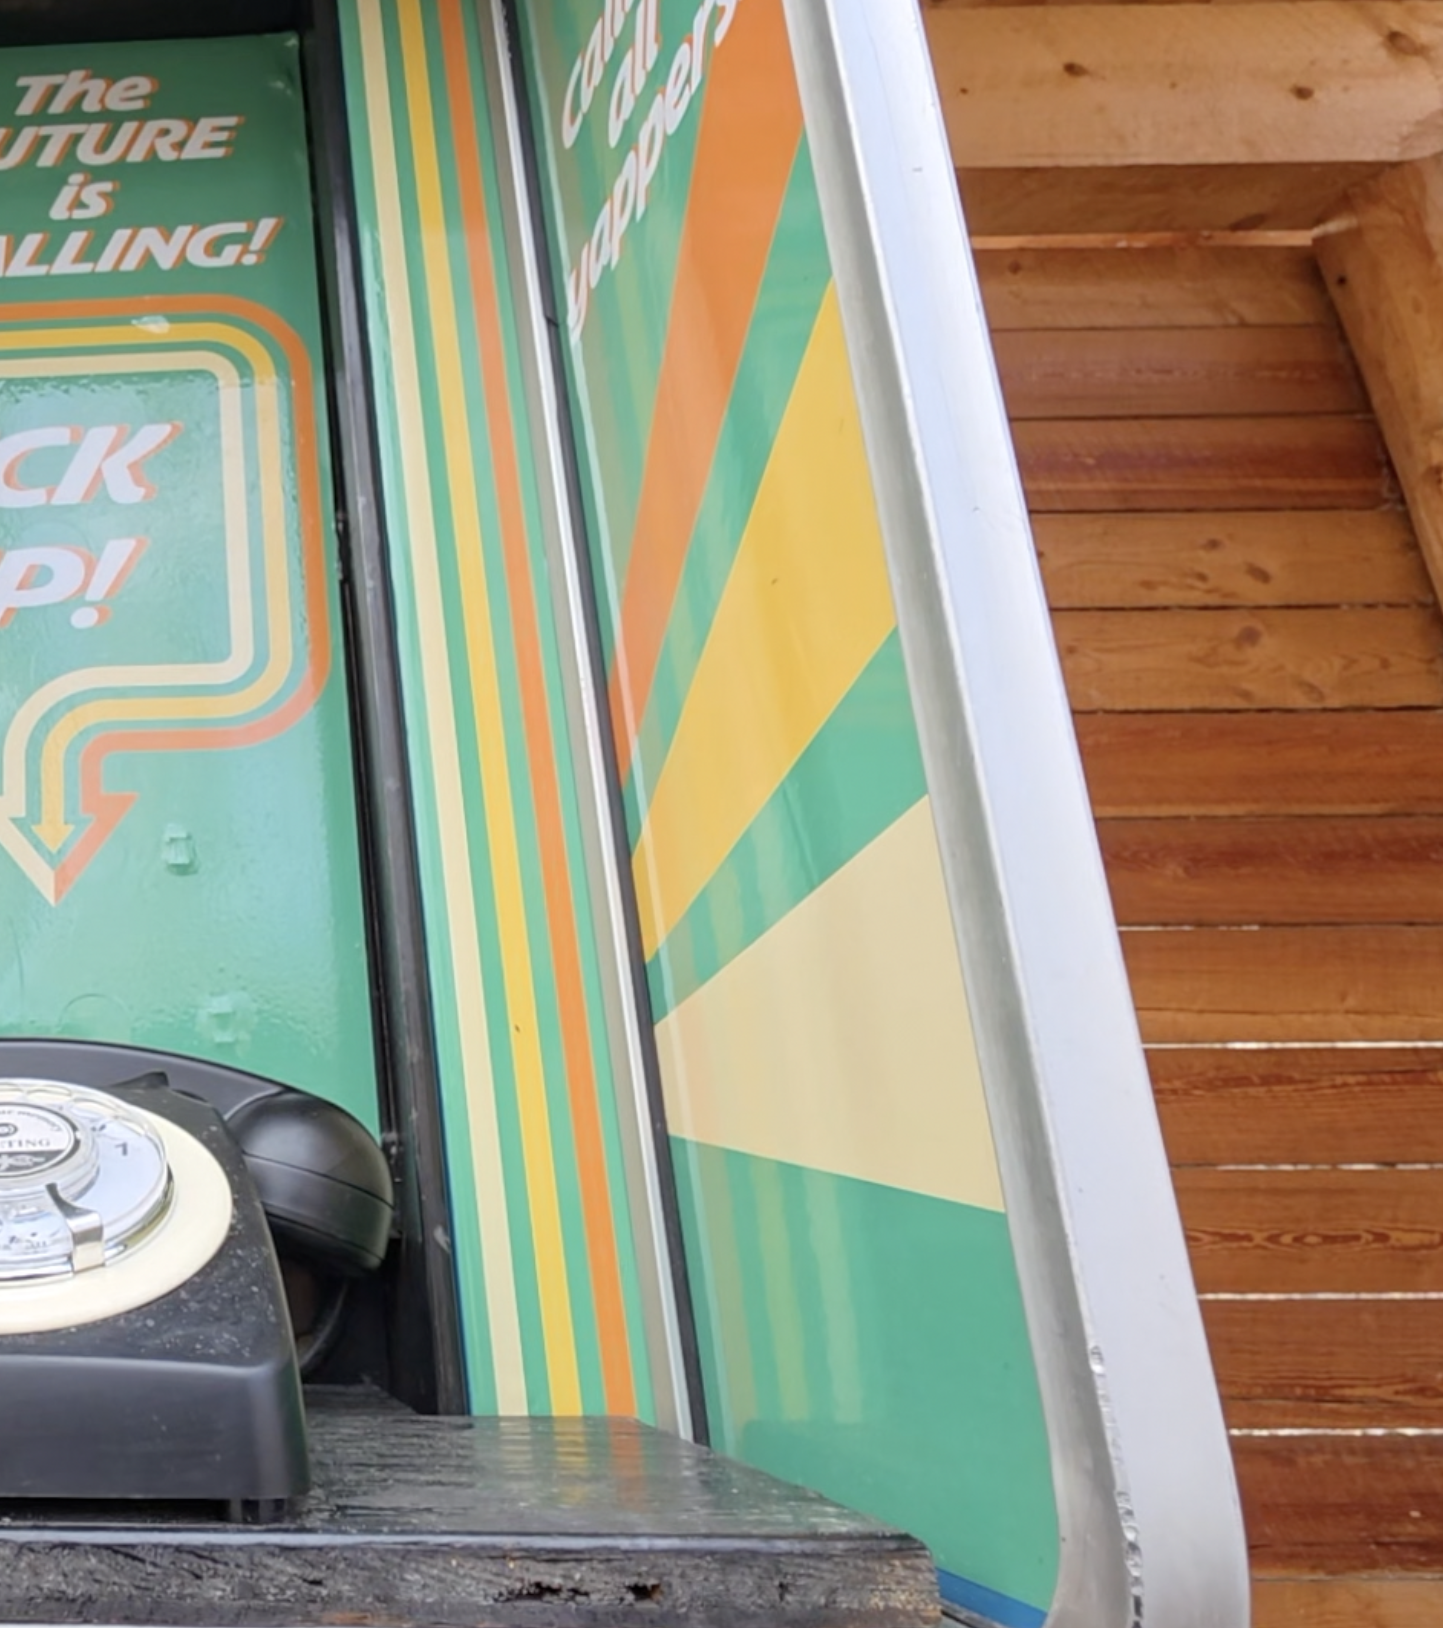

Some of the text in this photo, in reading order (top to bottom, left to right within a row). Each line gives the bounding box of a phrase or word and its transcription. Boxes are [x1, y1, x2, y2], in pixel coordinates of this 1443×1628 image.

[16, 69, 159, 116] The
[49, 172, 119, 220] is
[114, 1141, 129, 1157] 1
